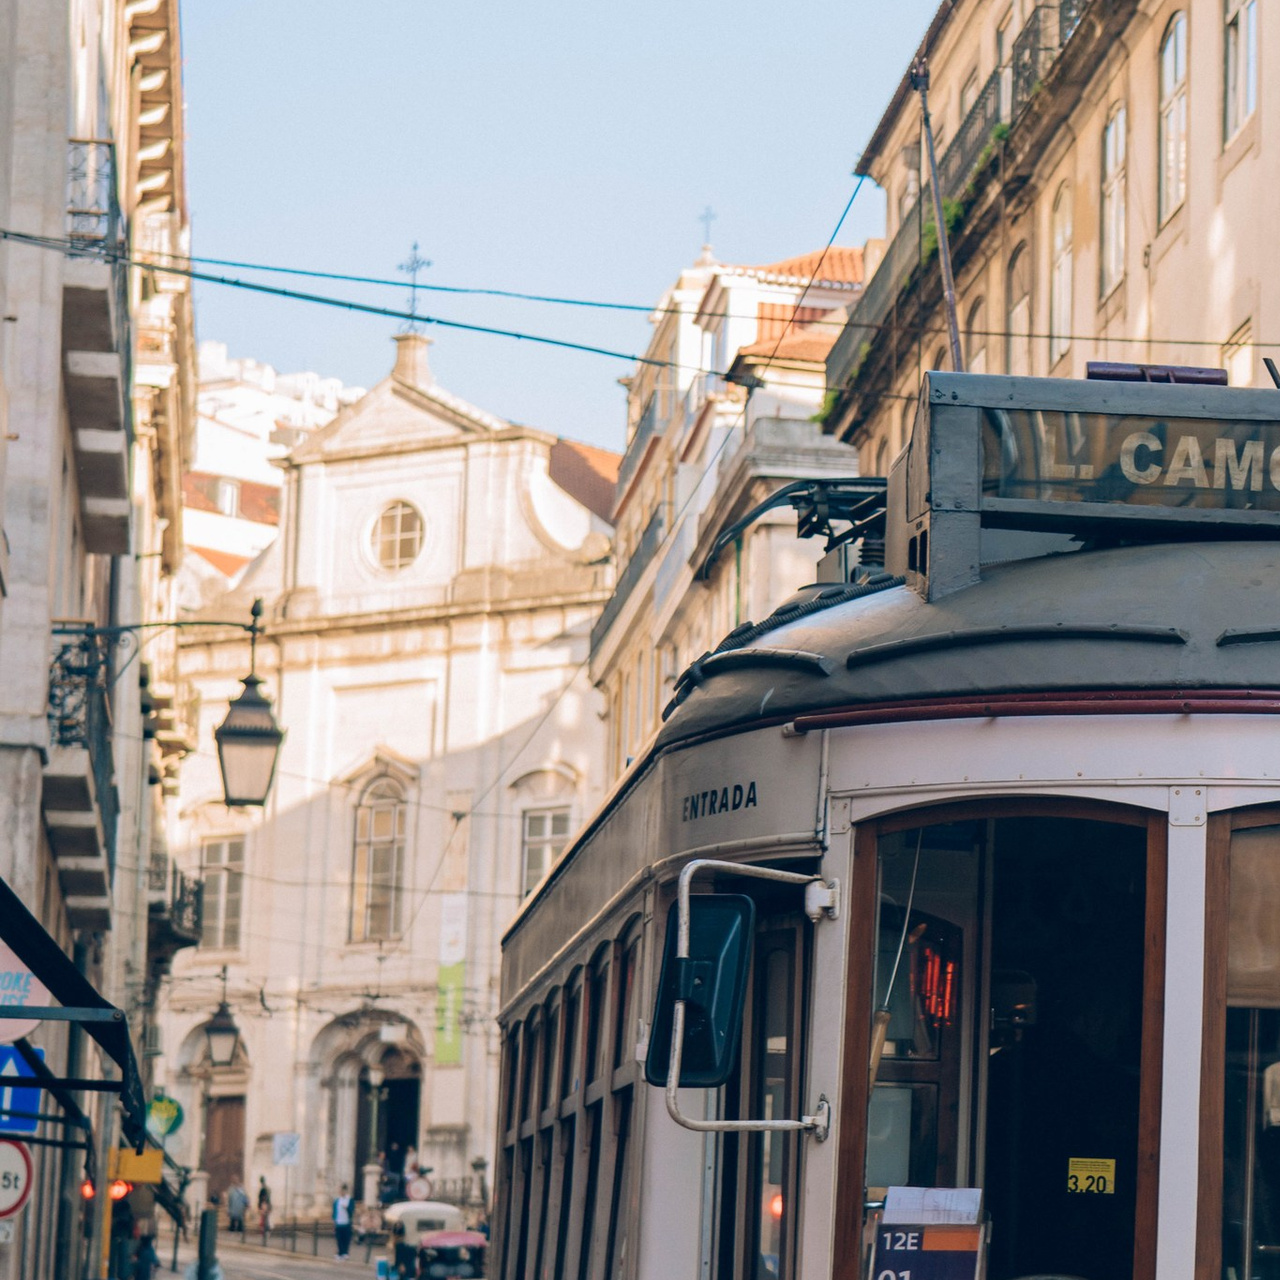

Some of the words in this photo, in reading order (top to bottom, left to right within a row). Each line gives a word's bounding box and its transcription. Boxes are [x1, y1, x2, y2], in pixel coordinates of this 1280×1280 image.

[1040, 425, 1094, 479] L.
[682, 781, 758, 823] ENTRADA
[883, 1232, 919, 1251] 12E
